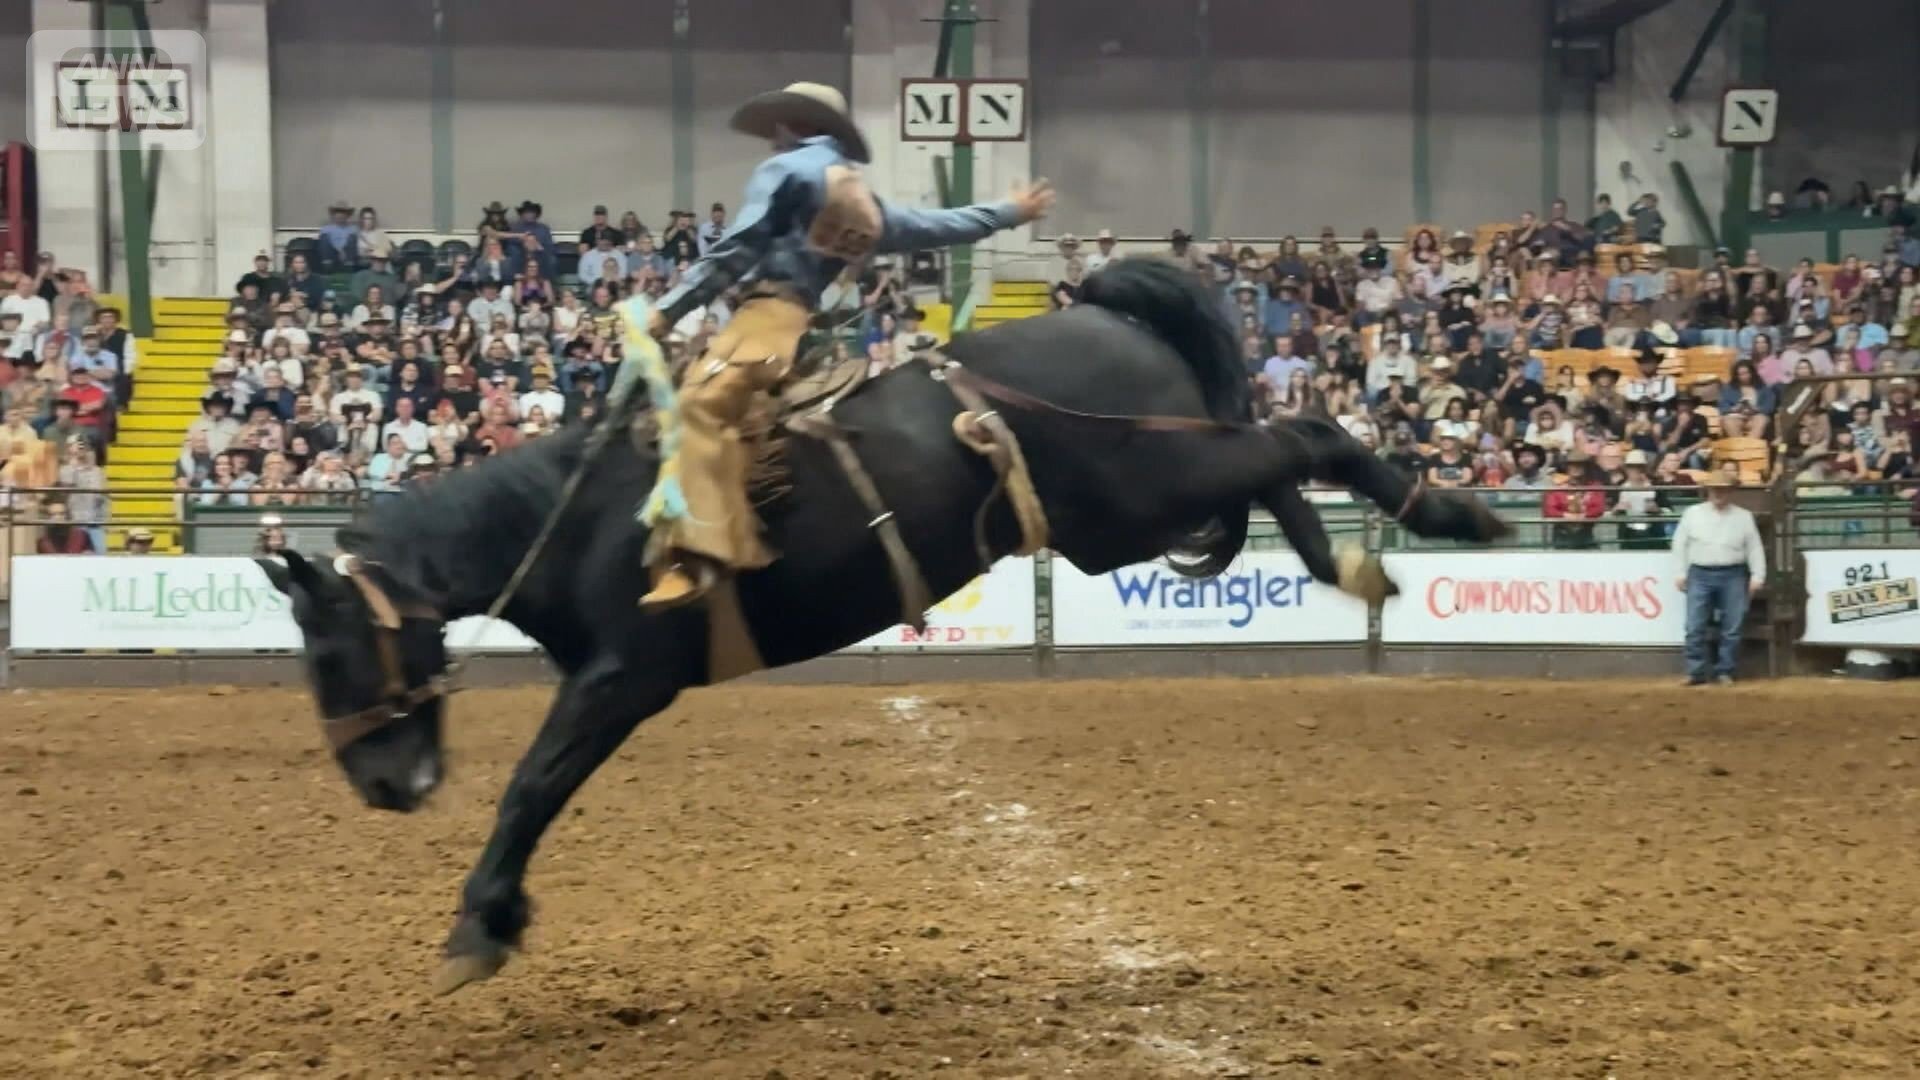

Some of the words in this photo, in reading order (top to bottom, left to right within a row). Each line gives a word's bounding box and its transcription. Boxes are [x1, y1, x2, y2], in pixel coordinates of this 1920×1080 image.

[907, 94, 954, 124] M
[976, 94, 1014, 126] N
[1731, 100, 1769, 128] N
[1111, 568, 1313, 627] Wrangler
[1426, 576, 1550, 619] COWBOYS
[1553, 576, 1662, 619] INDIANS
